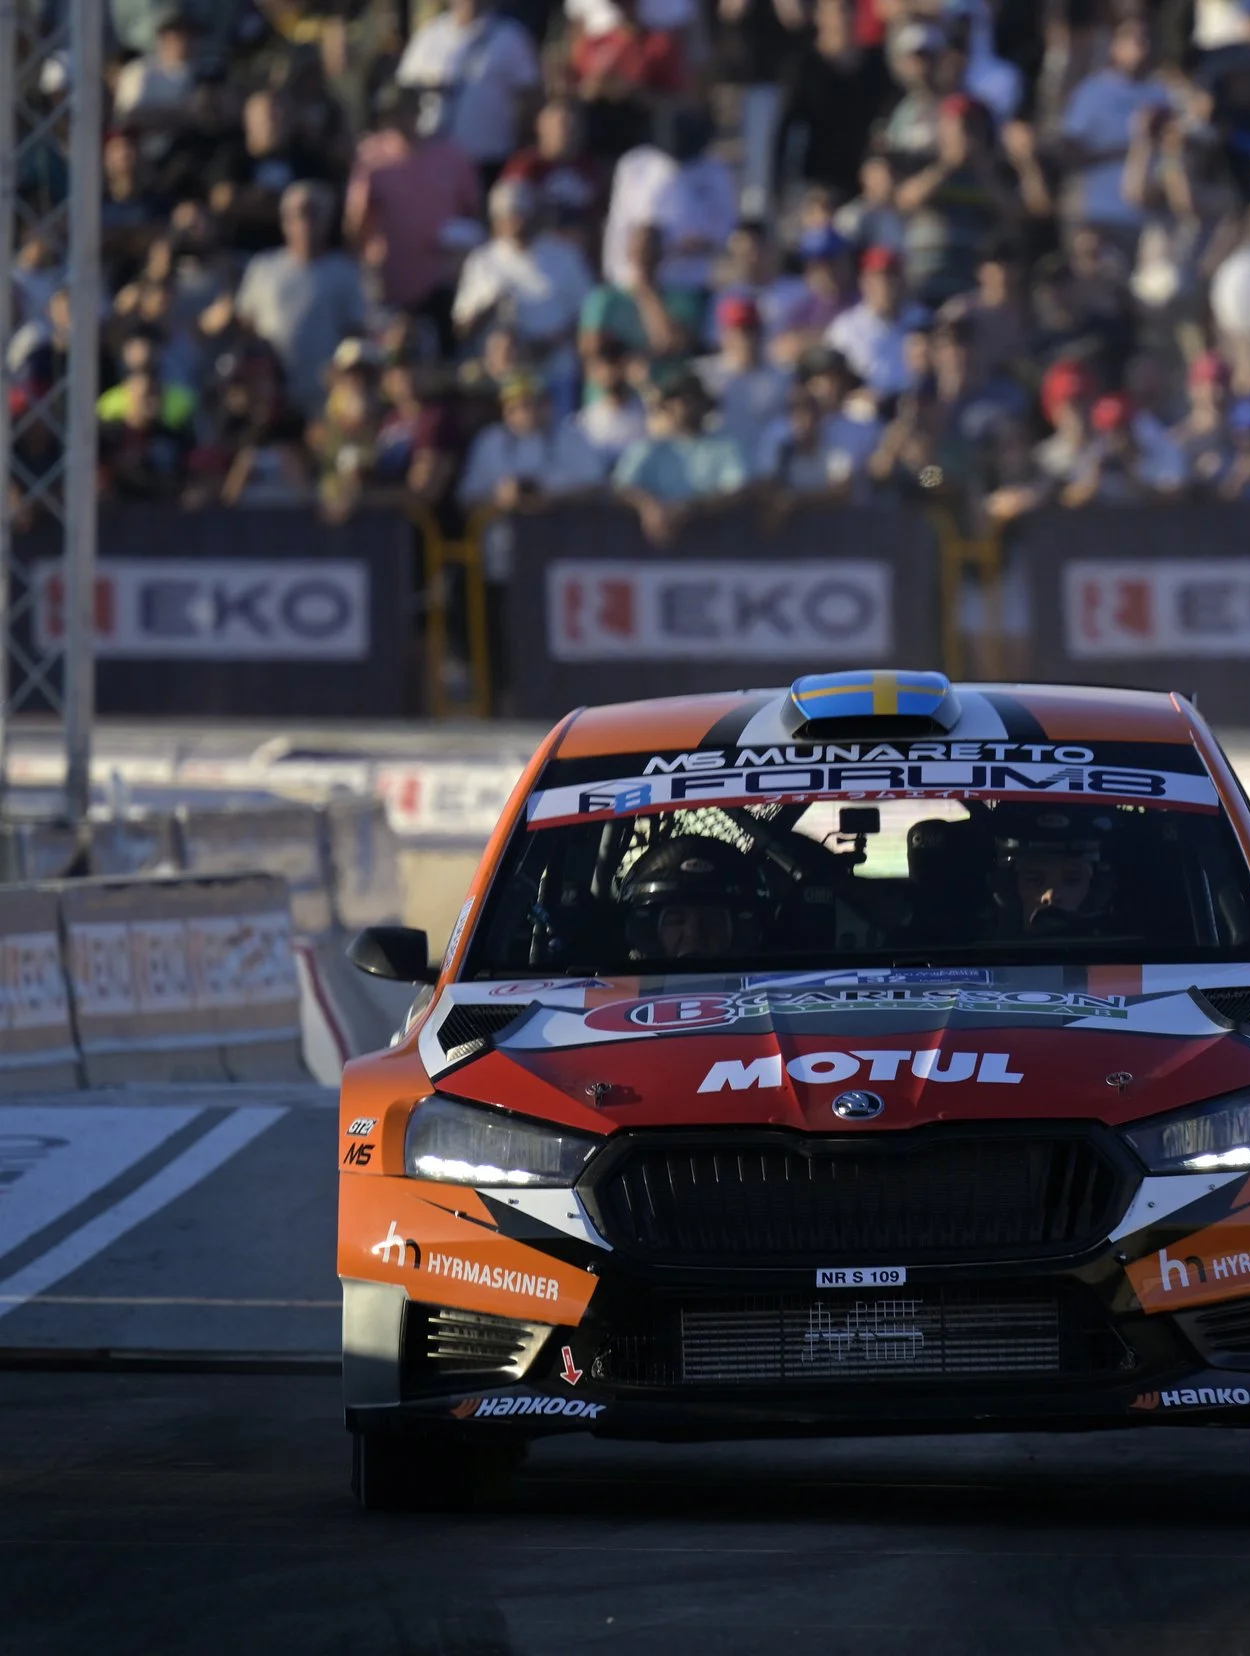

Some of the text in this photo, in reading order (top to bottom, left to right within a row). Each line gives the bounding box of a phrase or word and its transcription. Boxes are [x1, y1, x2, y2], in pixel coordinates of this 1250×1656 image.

[138, 578, 354, 640] EKO
[659, 578, 875, 639] EKO
[643, 743, 1095, 775] MS MUNARETTO
[671, 765, 1167, 800] FORUM8
[696, 1048, 1025, 1094] MOTUL
[427, 1251, 560, 1302] HYRMASKINER
[821, 1270, 901, 1285] NR S 109
